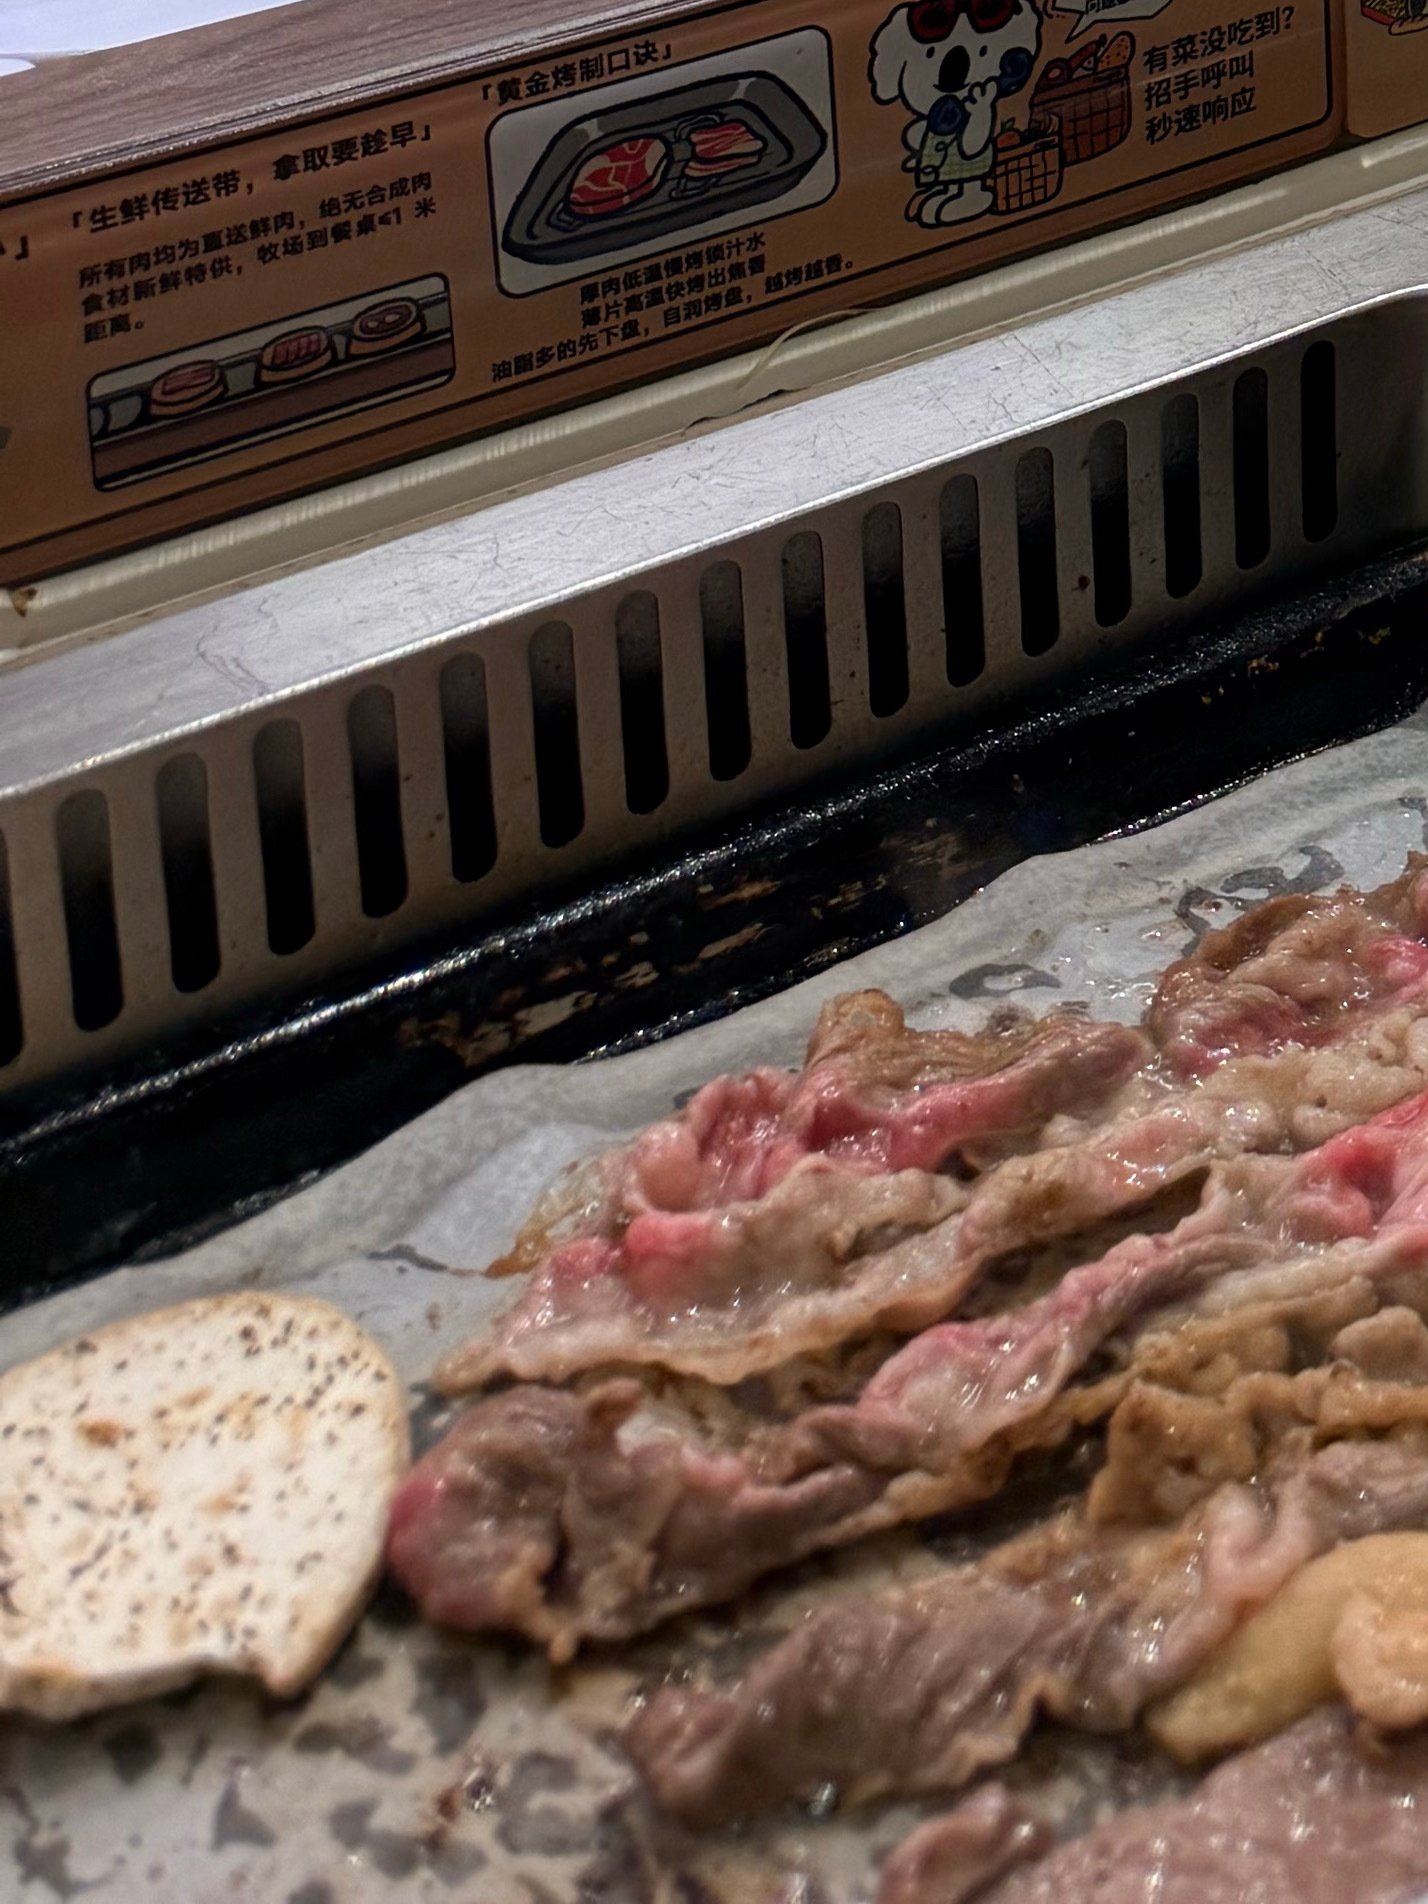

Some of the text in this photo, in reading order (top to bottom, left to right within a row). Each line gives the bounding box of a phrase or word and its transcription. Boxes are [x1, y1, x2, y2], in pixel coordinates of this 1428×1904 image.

[1143, 5, 1295, 75] 有菜没吃到?
[1145, 51, 1254, 112] 招手呼叫
[1145, 86, 1257, 145] 秒速响应
